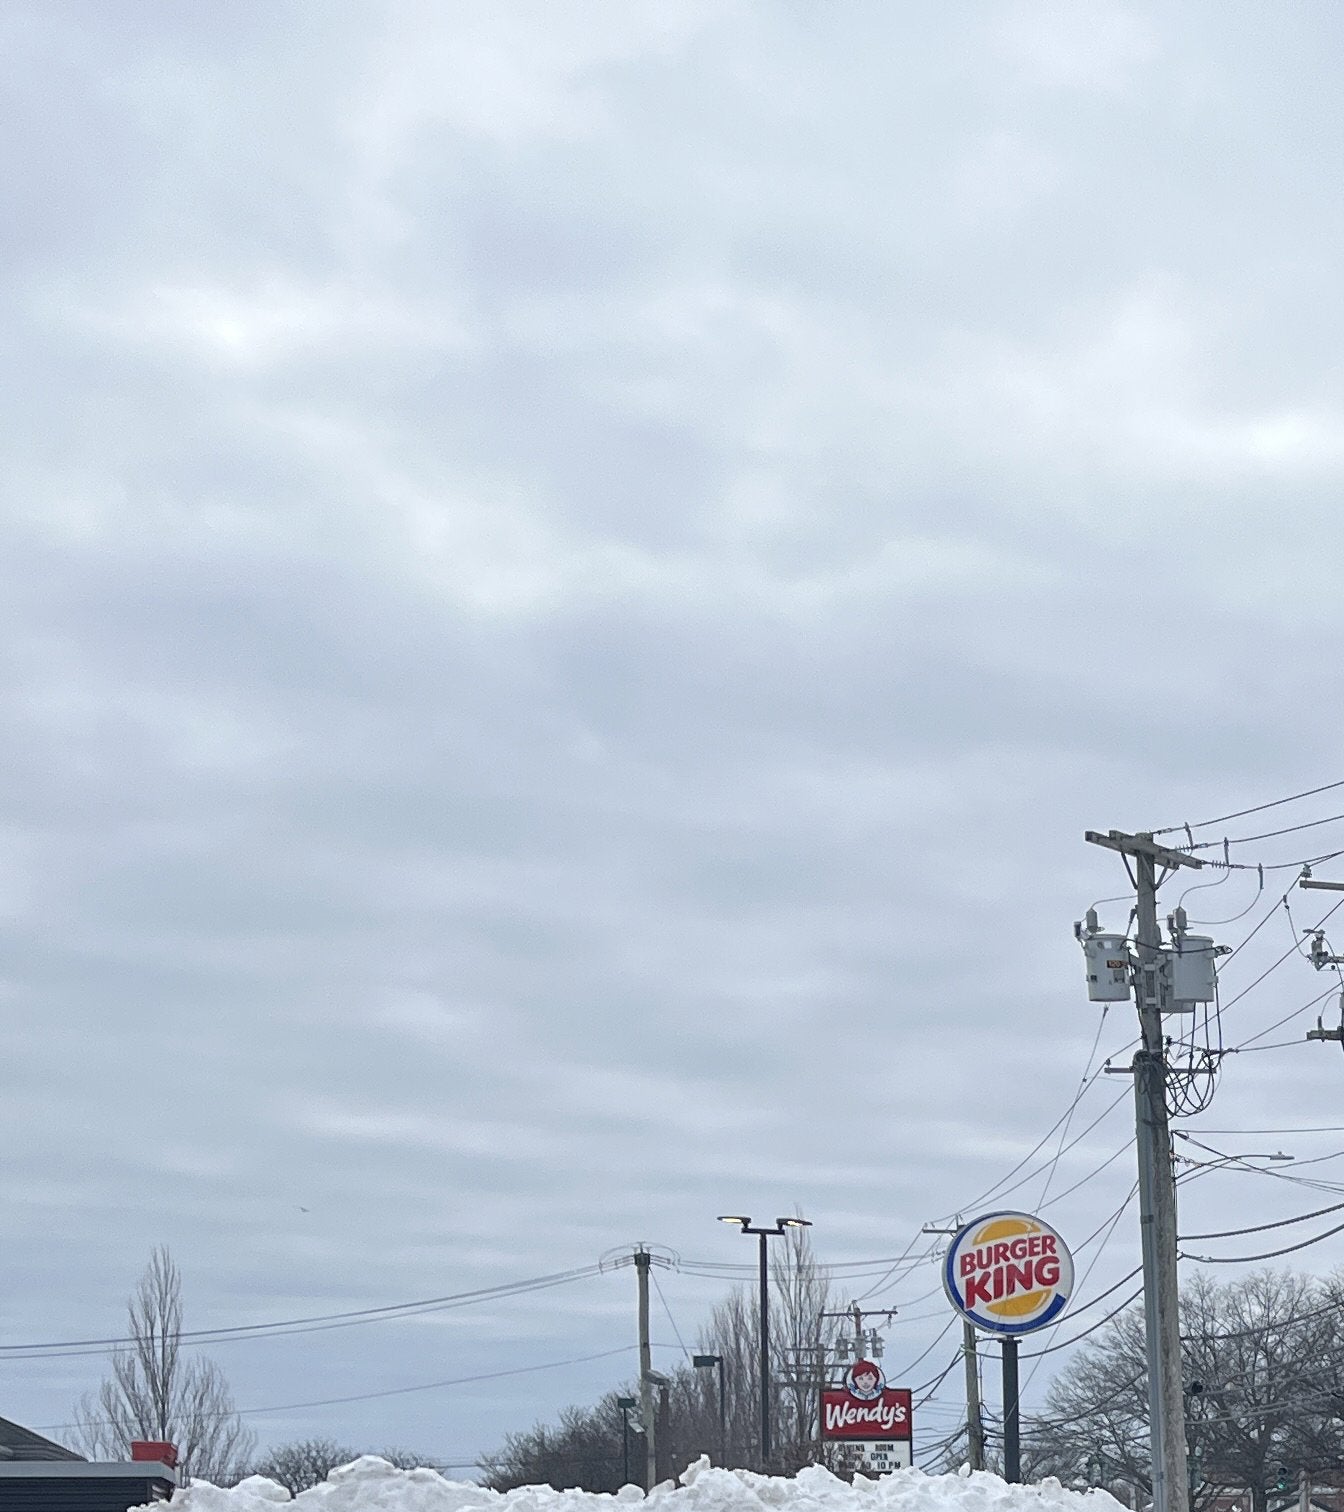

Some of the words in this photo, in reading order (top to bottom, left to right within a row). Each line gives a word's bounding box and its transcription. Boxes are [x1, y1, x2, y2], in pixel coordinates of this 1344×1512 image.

[960, 1235, 1056, 1277] BURGER
[965, 1256, 1060, 1309] KING
[826, 1398, 907, 1430] Wendy's
